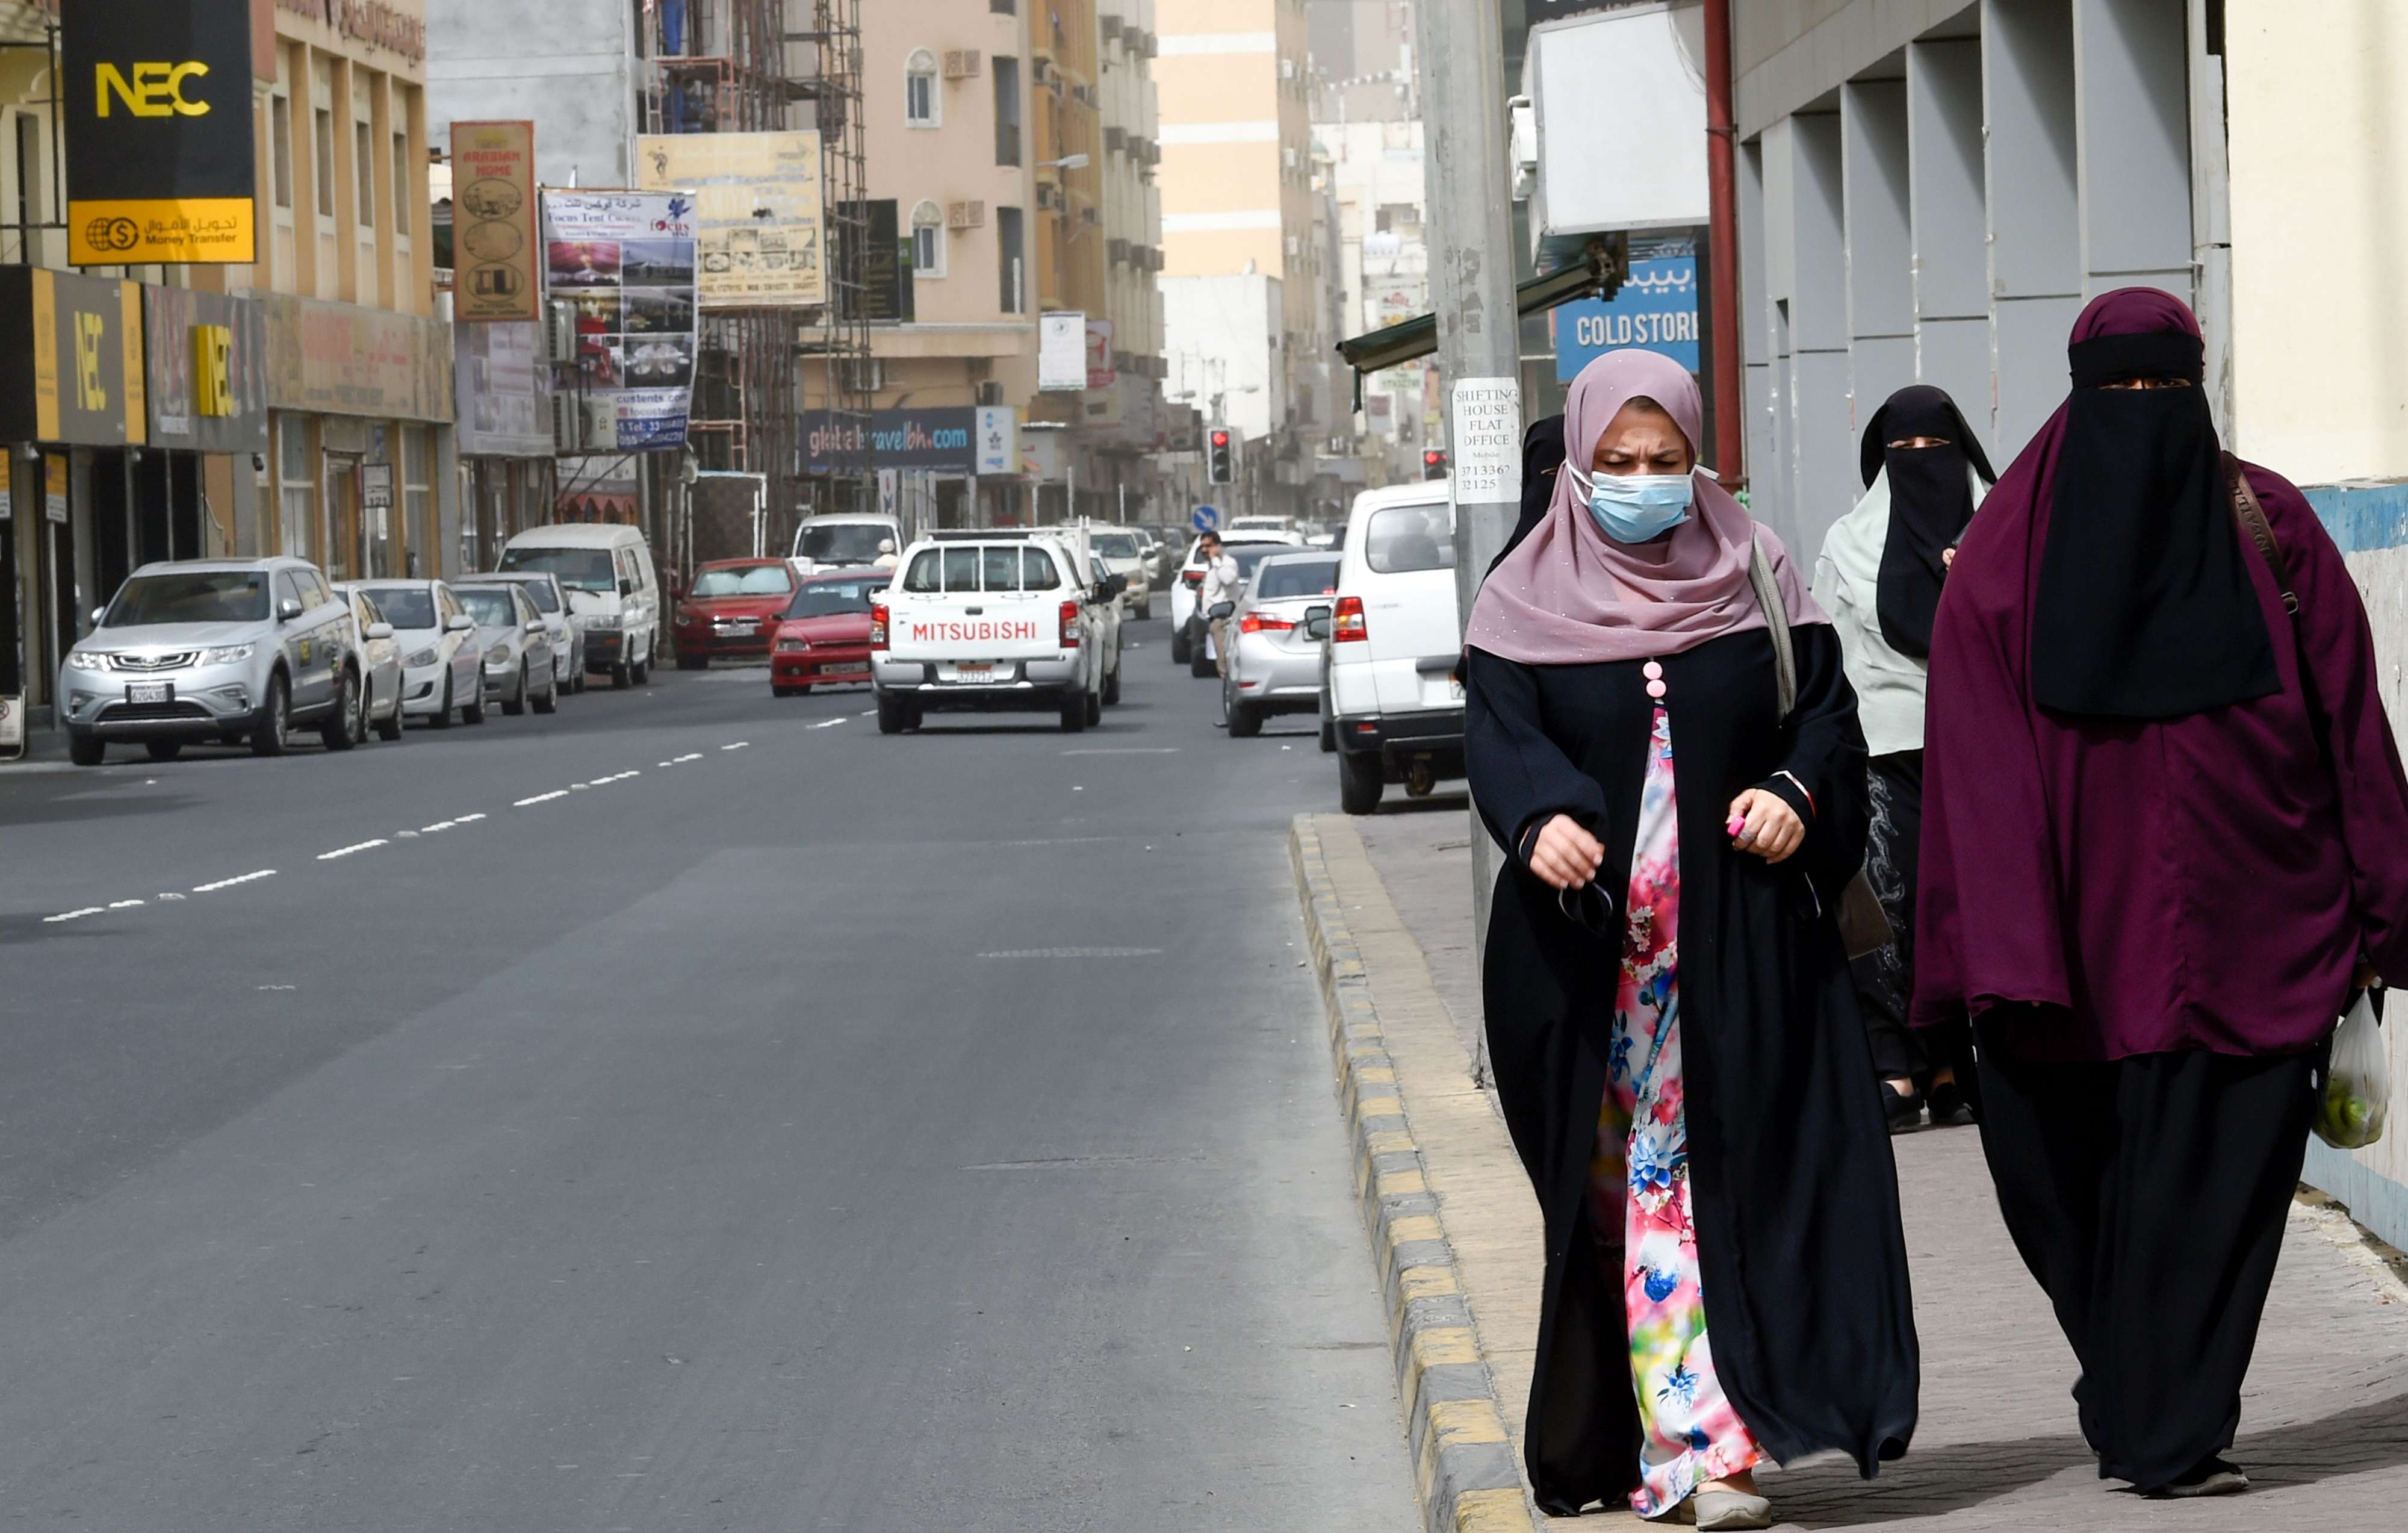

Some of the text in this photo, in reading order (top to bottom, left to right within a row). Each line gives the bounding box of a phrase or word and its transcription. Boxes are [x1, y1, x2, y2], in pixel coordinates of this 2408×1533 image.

[96, 61, 211, 117] NEC
[548, 213, 578, 223] Focus
[582, 213, 605, 222] Tent
[144, 216, 237, 233] تحويل الأموال
[145, 233, 237, 245] Money Transfer
[1577, 315, 1632, 346] COLD
[1463, 404, 1509, 416] HOUSE
[1469, 420, 1503, 431] FLAT
[1464, 434, 1510, 446] OFFICE
[913, 622, 1036, 641] MITSUBISHI
